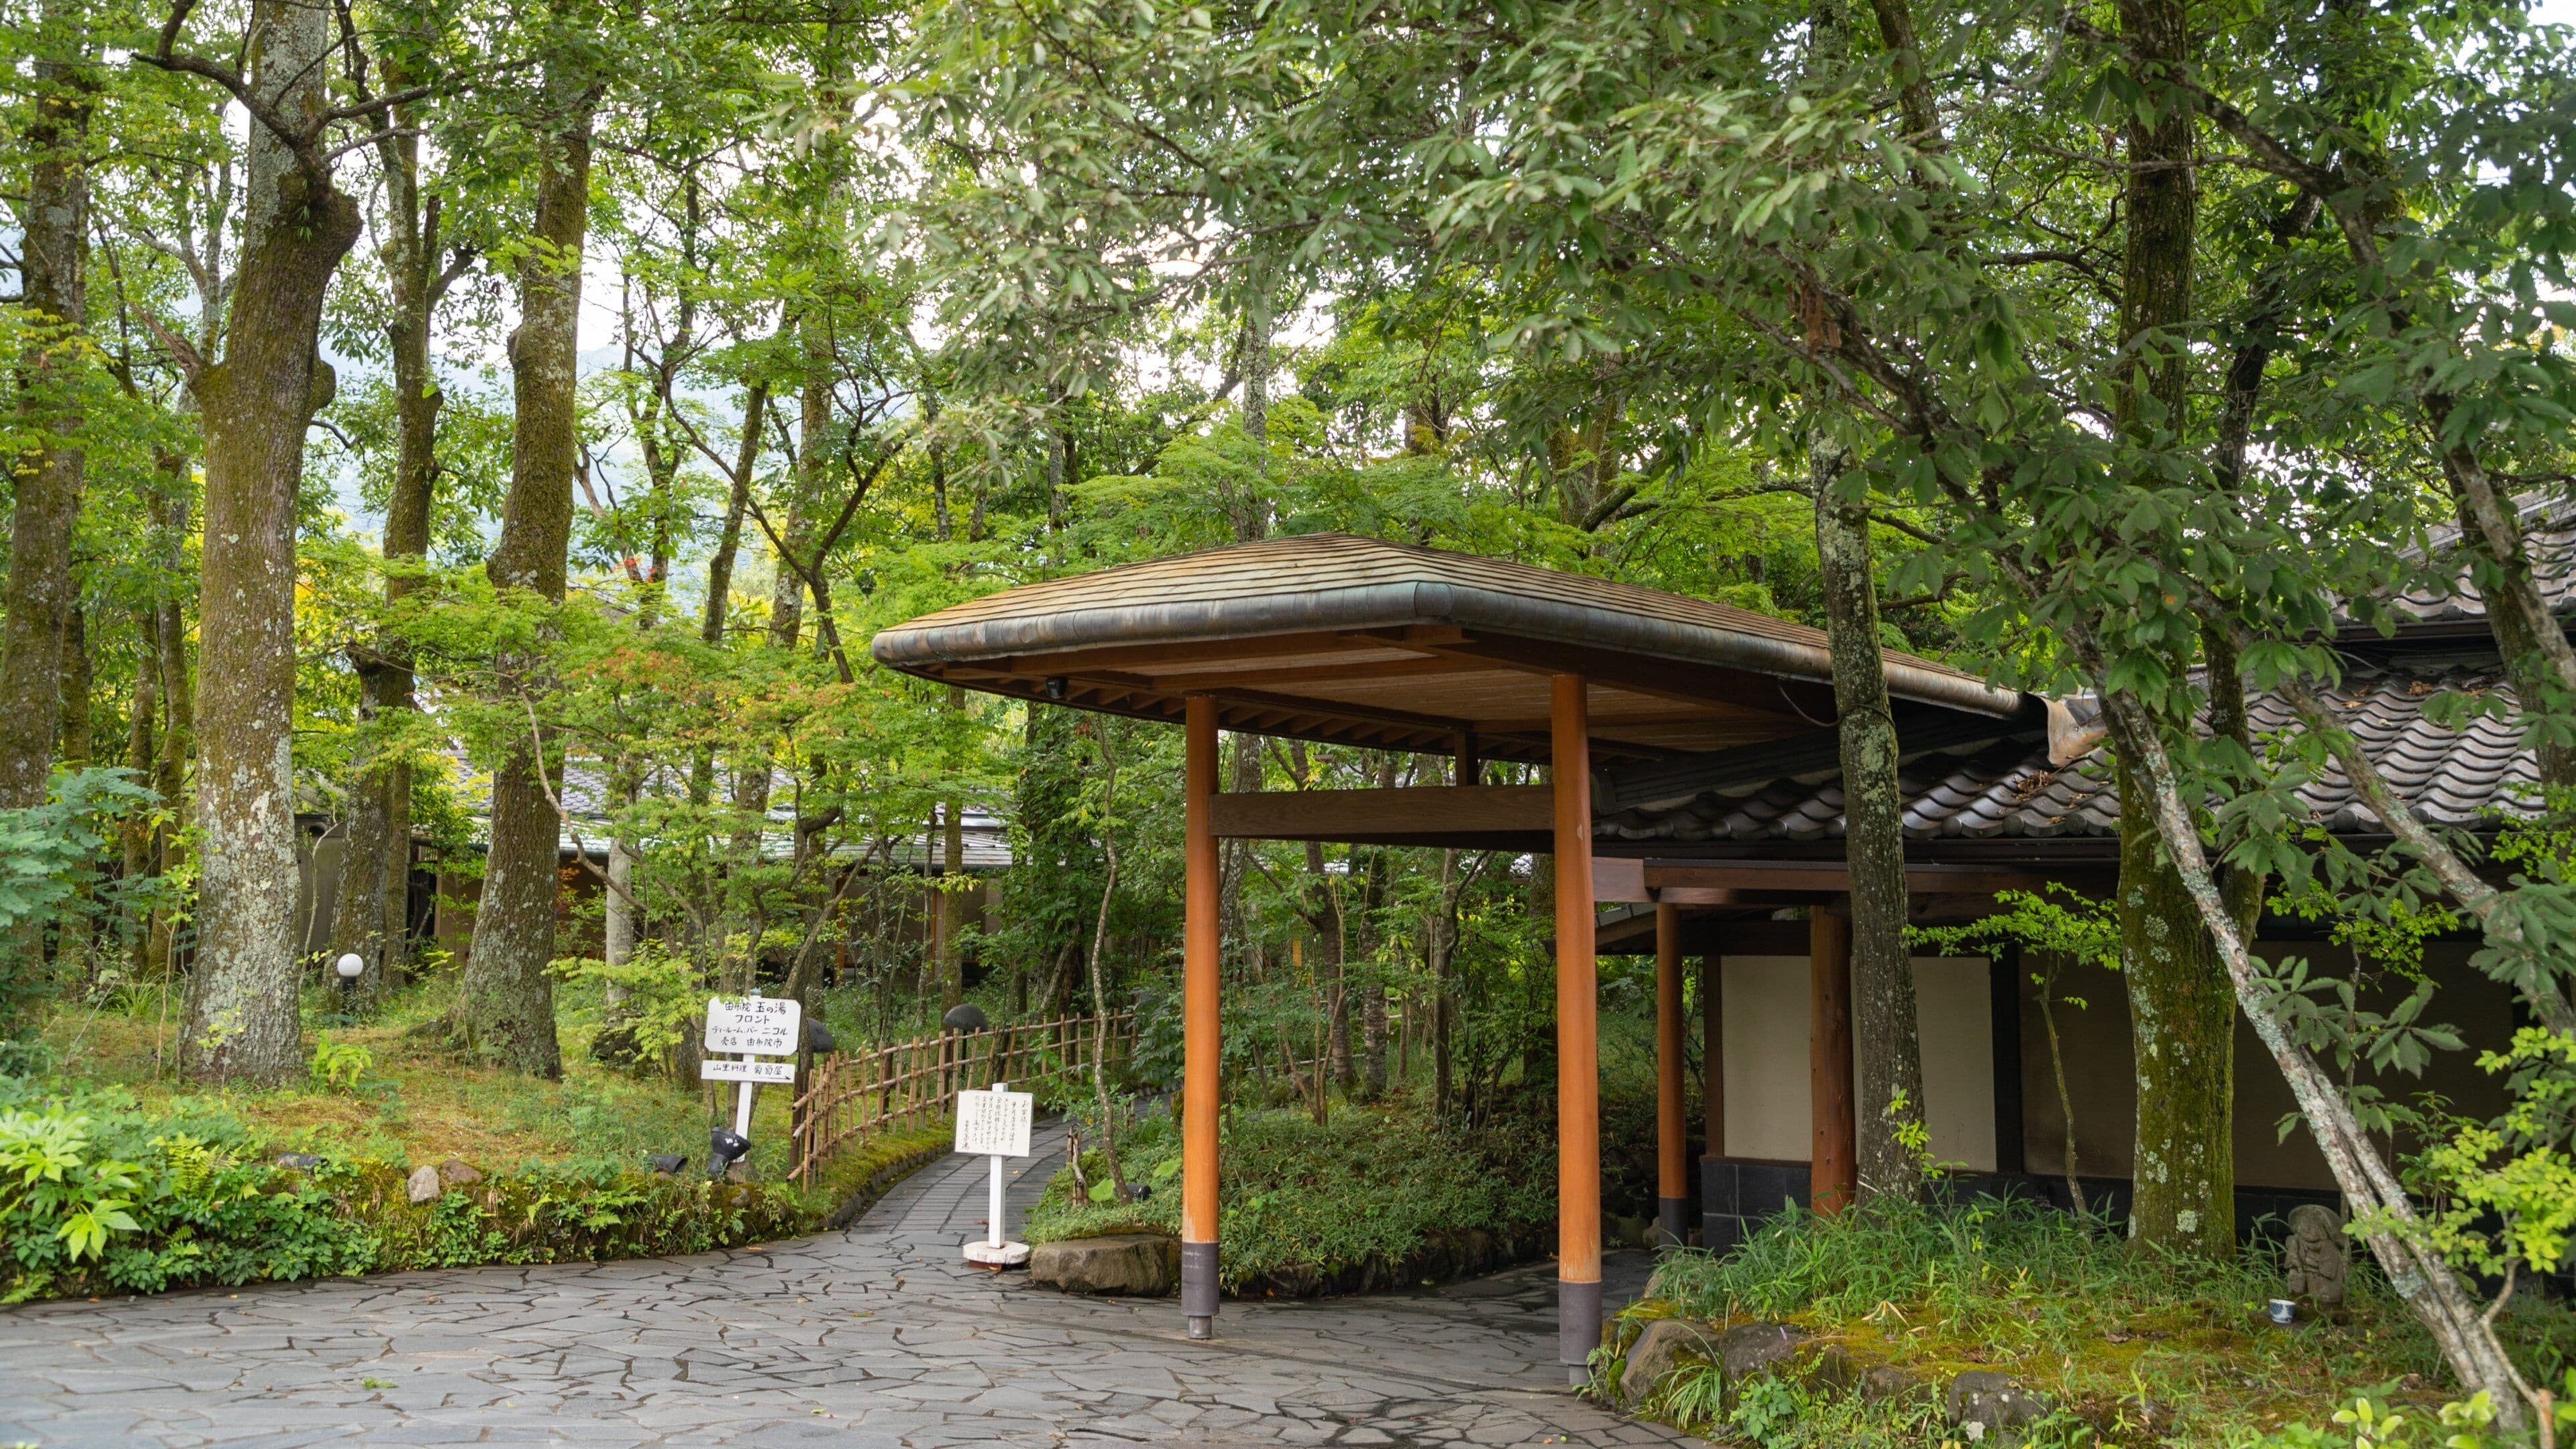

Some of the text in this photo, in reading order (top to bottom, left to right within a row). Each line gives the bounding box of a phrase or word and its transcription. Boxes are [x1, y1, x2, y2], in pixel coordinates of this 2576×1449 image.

[755, 1002, 787, 1015] 玉の湯
[735, 1014, 770, 1024] フロント
[762, 1027, 789, 1036] ニコル
[720, 1036, 783, 1048] 売店 由布院市
